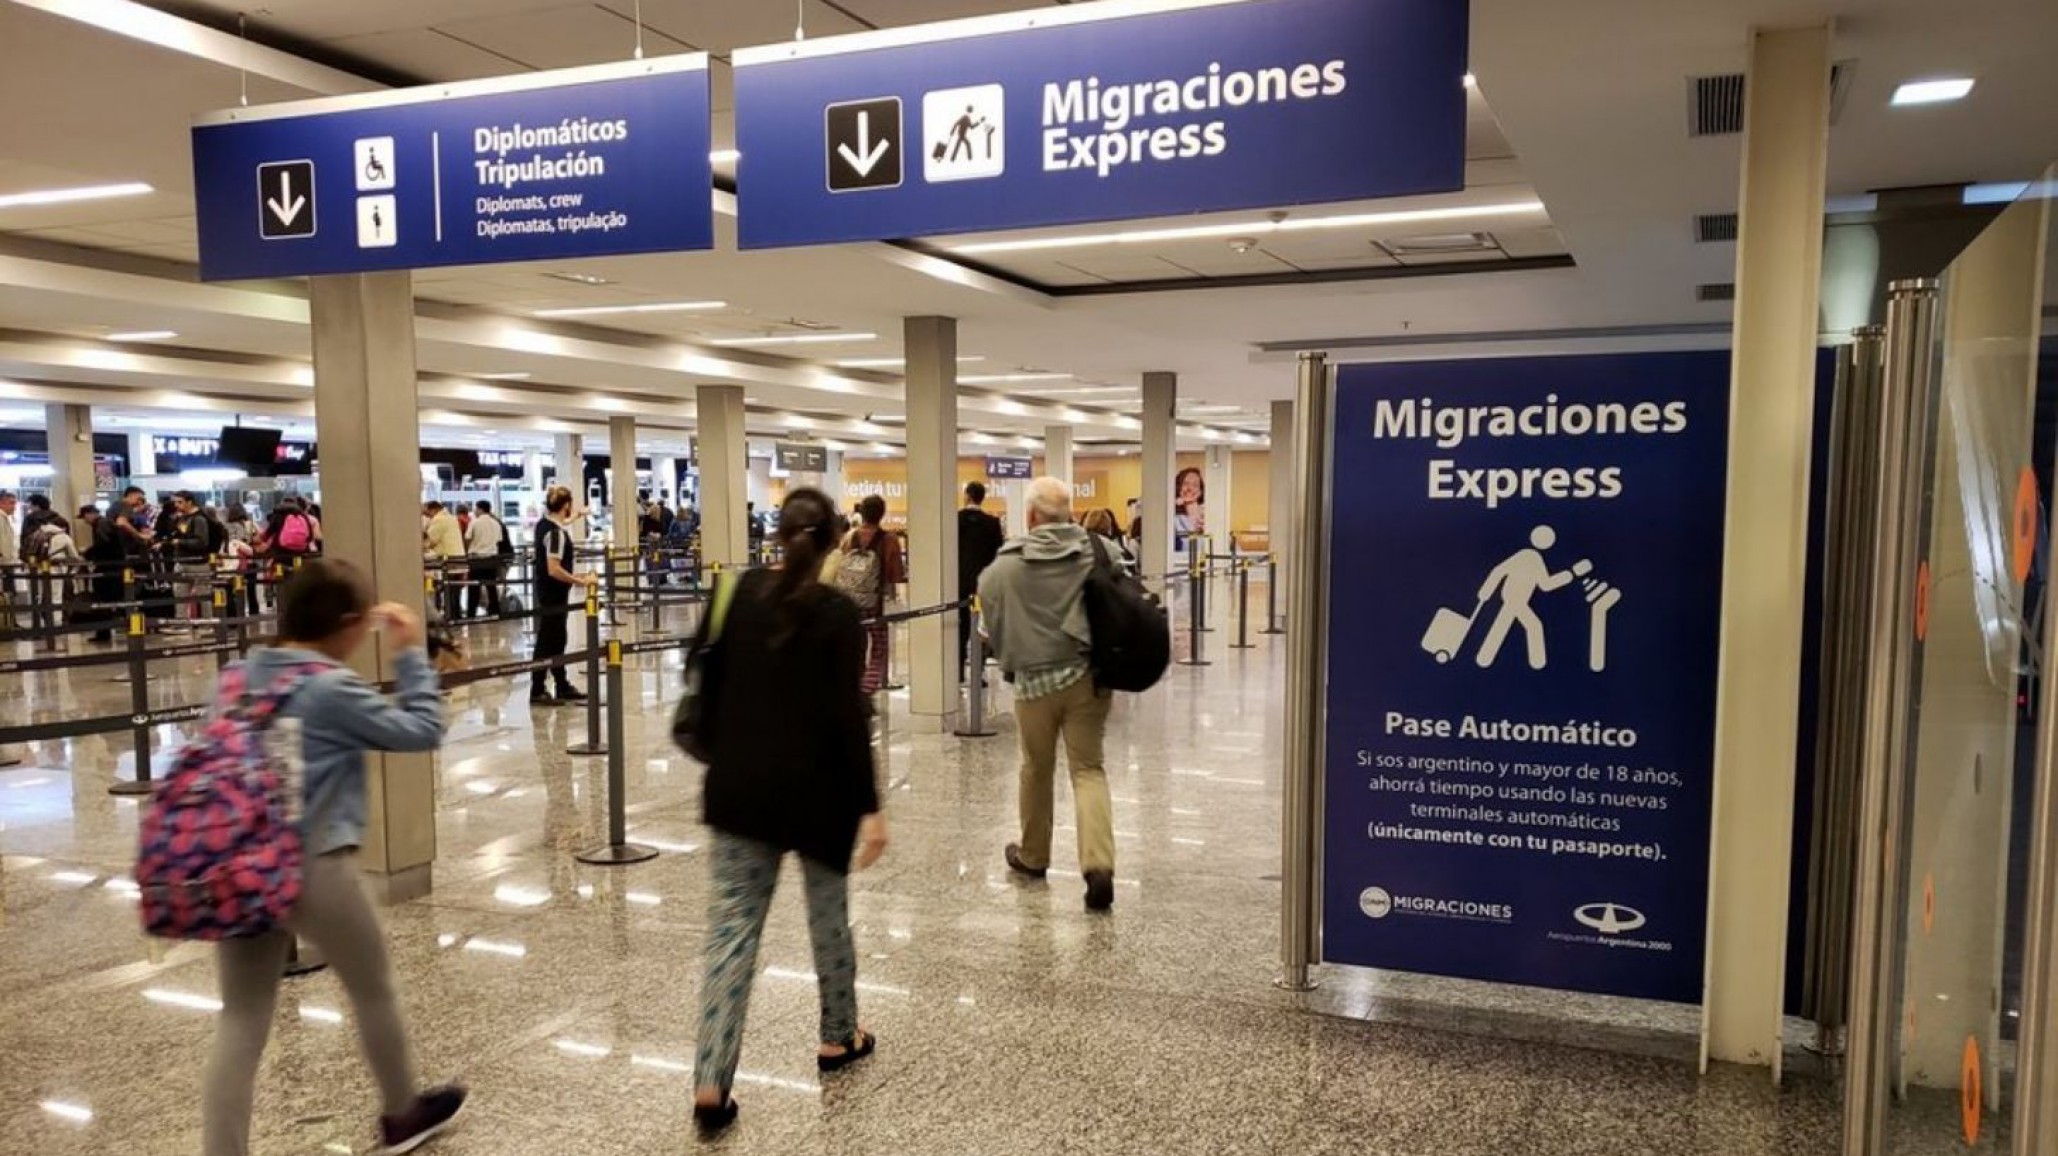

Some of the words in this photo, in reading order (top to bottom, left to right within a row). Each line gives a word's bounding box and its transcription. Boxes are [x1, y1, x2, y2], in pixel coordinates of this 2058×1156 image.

[1042, 58, 1347, 132] Migraciones
[474, 116, 628, 157] Diplomáticos
[1042, 120, 1227, 178] Express
[474, 150, 605, 189] Tripulación
[475, 194, 547, 216] Diplomats,
[549, 192, 584, 210] crew
[476, 218, 555, 240] Diplomatas,
[557, 210, 628, 234] tripulação
[1373, 393, 1687, 449] Migraciones
[1427, 459, 1623, 509] Express
[1384, 711, 1451, 738] Pase
[1457, 715, 1638, 748] Automático
[1356, 750, 1372, 766] Si
[1376, 754, 1403, 768] sos
[1407, 756, 1495, 775] argentino
[1498, 762, 1510, 777] y
[1513, 762, 1572, 780] mayor
[1576, 763, 1601, 780] de
[1606, 765, 1629, 783] 18
[1632, 768, 1684, 788] años,
[1369, 775, 1426, 793] ahorrá
[1429, 778, 1495, 800] tiempo
[1498, 784, 1567, 803] usando
[1570, 786, 1596, 805] las
[1599, 790, 1668, 810] nuevas
[1410, 802, 1504, 823] terminales
[1507, 807, 1621, 832] automáticas
[1367, 821, 1485, 846] (únicamente
[1487, 833, 1522, 848] con
[1526, 833, 1549, 850] tu
[1551, 837, 1668, 862] pasaporte).
[1394, 896, 1512, 918] MIGRACIONES
[1597, 936, 1647, 949] Argentina
[1647, 940, 1673, 951] 2000
